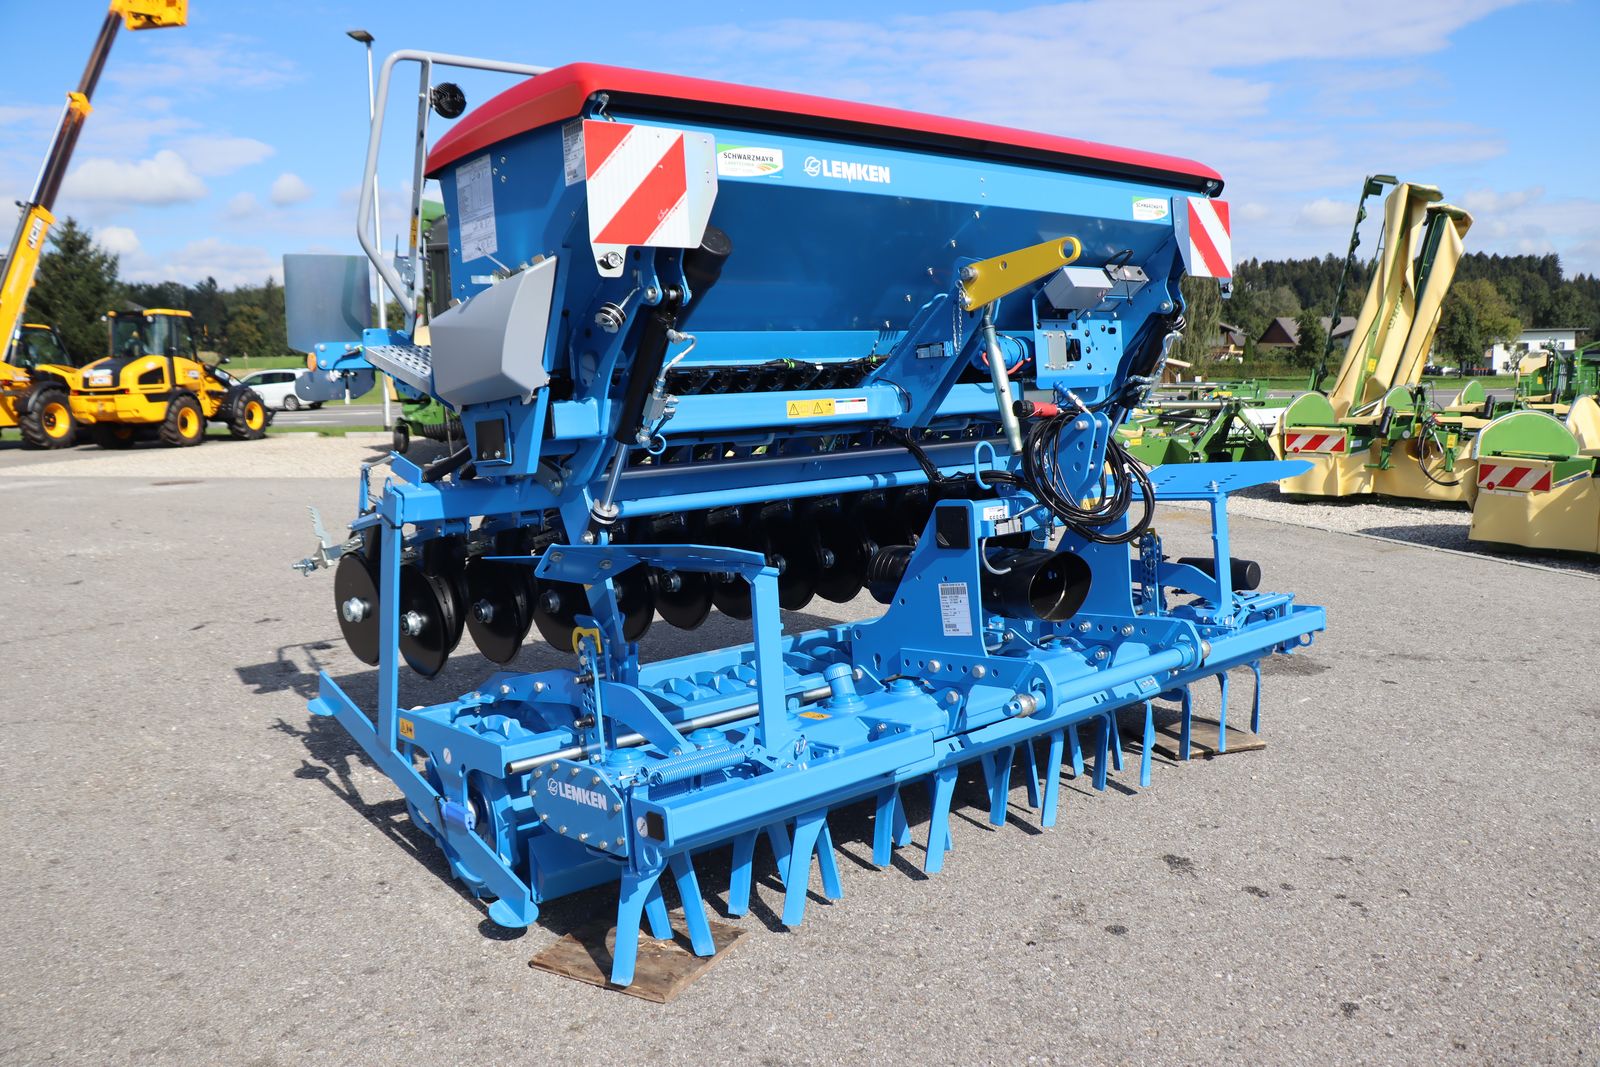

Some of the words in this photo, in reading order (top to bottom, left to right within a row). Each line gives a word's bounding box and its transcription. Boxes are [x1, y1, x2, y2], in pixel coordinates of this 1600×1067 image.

[723, 151, 774, 163] SCHWARZMAYR
[822, 158, 891, 183] LEMKEN
[558, 781, 608, 811] LEMKEN
